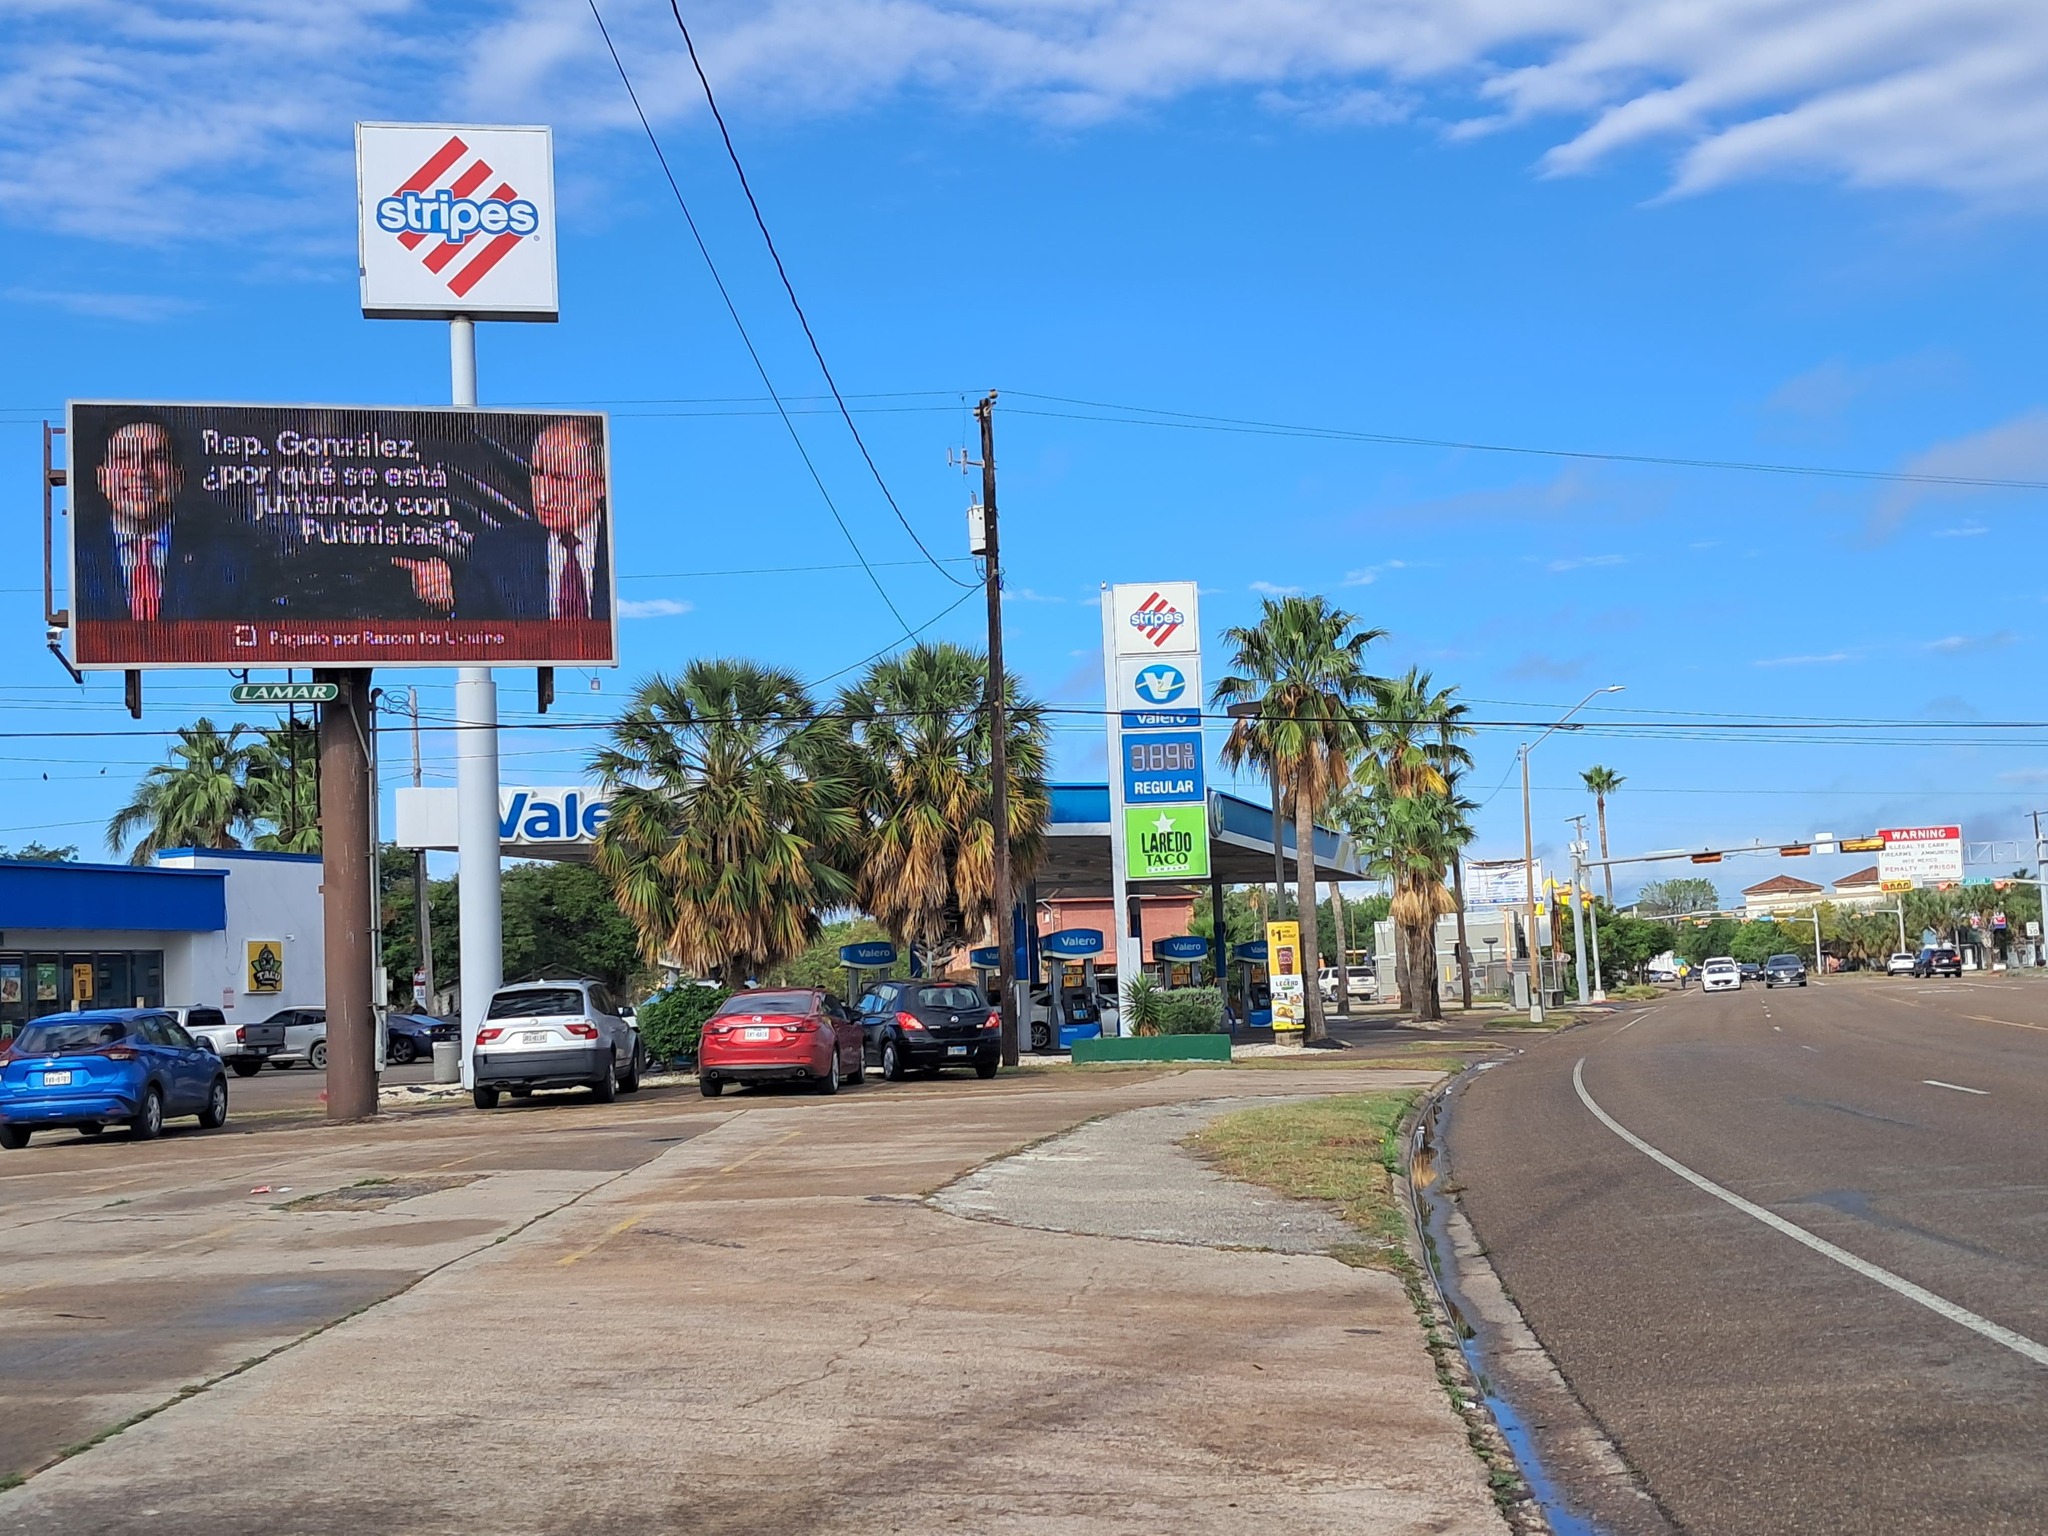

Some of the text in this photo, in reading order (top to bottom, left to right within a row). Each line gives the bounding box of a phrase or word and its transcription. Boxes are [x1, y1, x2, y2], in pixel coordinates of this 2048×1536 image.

[378, 191, 538, 242] stripes
[202, 429, 269, 461] Rep.
[202, 460, 448, 491] ¿por qué se está
[254, 487, 450, 521] juntando con
[1130, 610, 1184, 629] stripes
[333, 631, 359, 648] por
[239, 686, 328, 700] LAMAR
[1134, 780, 1194, 795] REGULAR
[1141, 831, 1192, 853] LAREDO
[1891, 829, 1946, 840] WARNING
[1144, 852, 1188, 866] TACO
[1061, 936, 1097, 946] Valero
[1172, 943, 1201, 951] Valero
[858, 948, 891, 958] Valero
